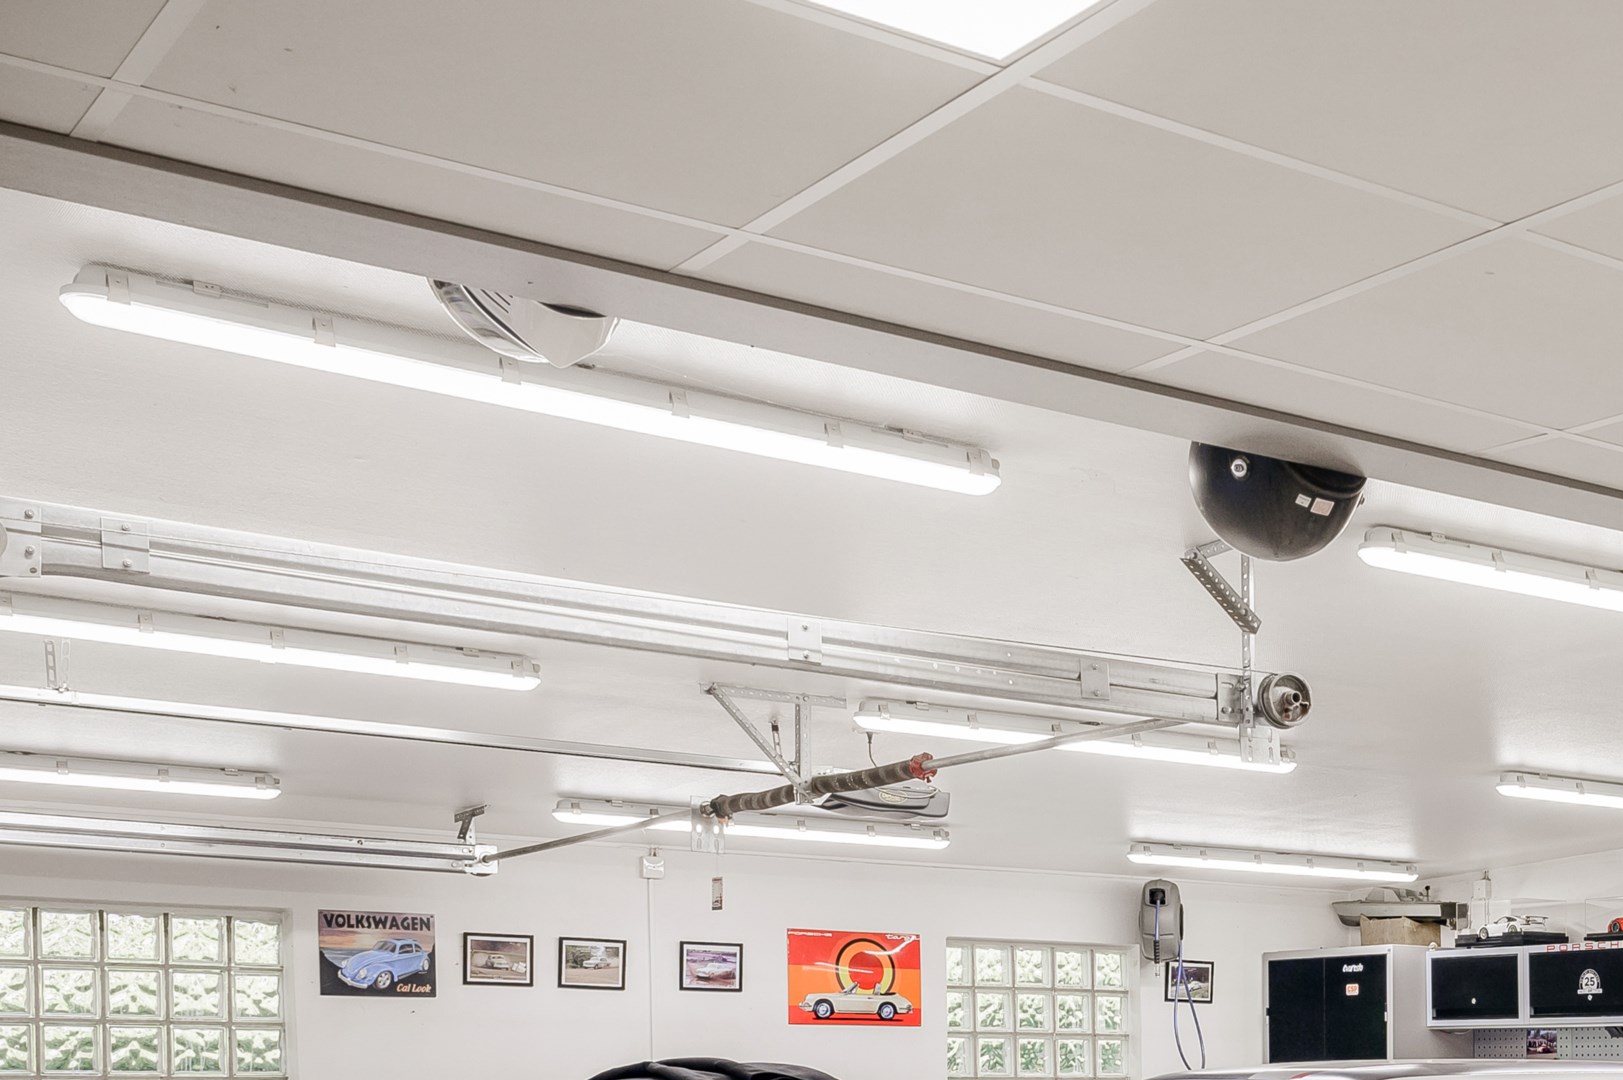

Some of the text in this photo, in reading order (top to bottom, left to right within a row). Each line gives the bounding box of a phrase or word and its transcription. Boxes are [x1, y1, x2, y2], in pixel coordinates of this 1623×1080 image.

[323, 913, 431, 931] VOLKSWAGEN
[1584, 977, 1596, 987] 25
[396, 983, 432, 993] Cal Look
